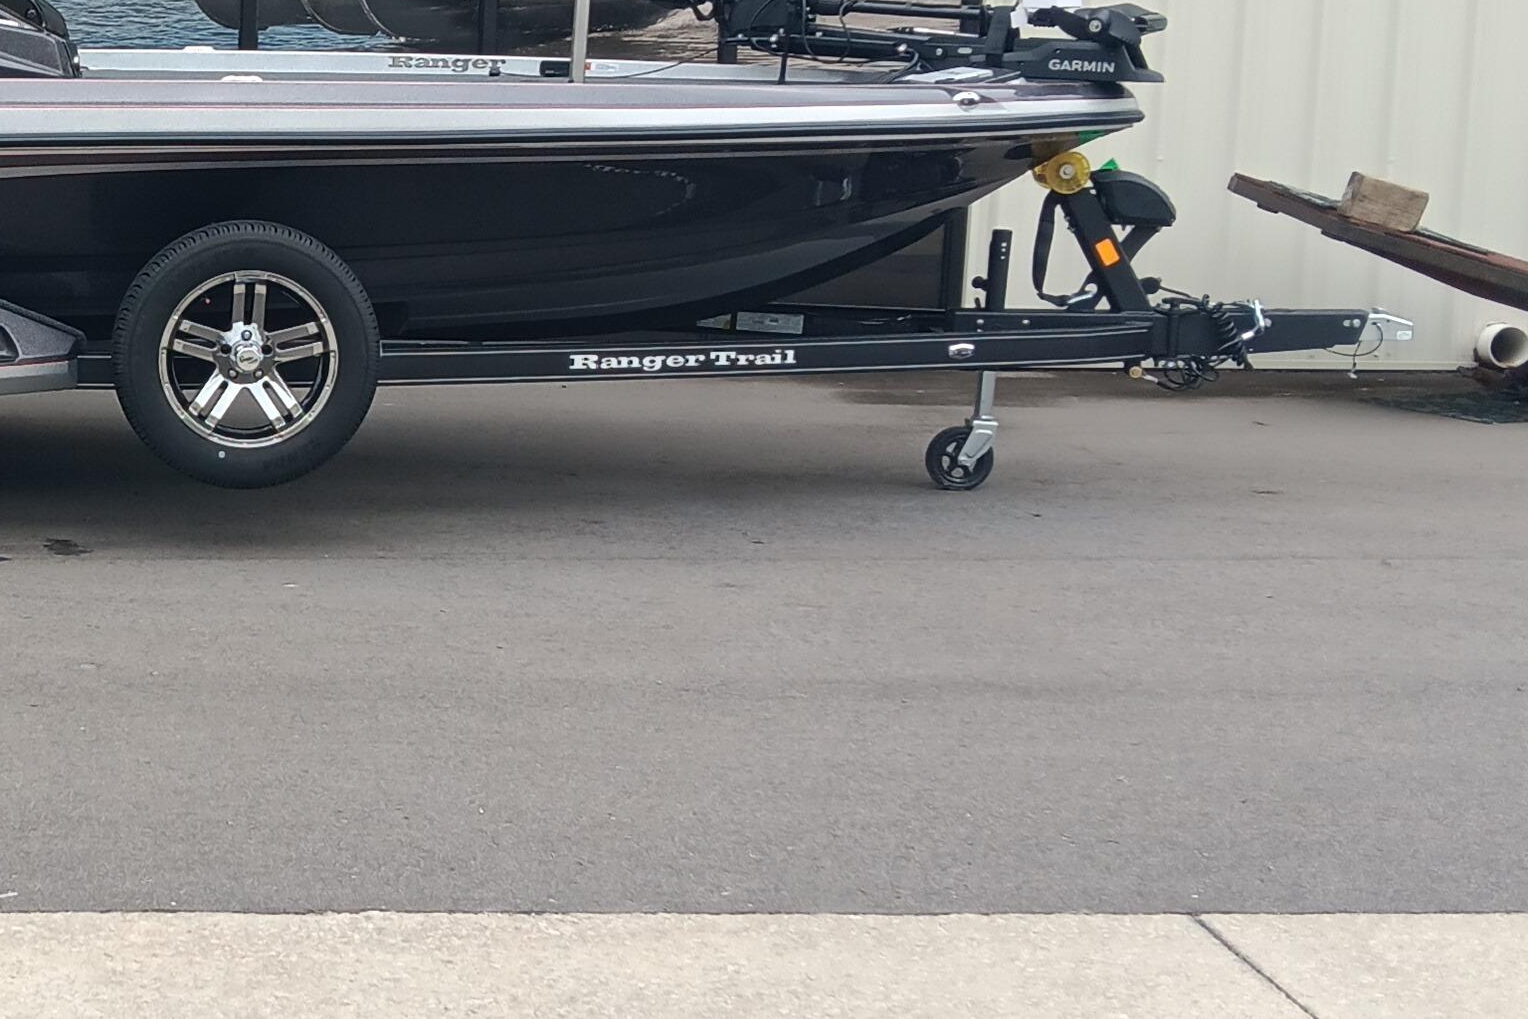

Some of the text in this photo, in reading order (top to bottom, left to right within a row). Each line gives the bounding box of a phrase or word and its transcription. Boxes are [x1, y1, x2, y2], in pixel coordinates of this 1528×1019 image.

[387, 55, 507, 73] Ranger
[1048, 58, 1115, 73] GARMIN
[568, 349, 797, 372] Ranger Trail
